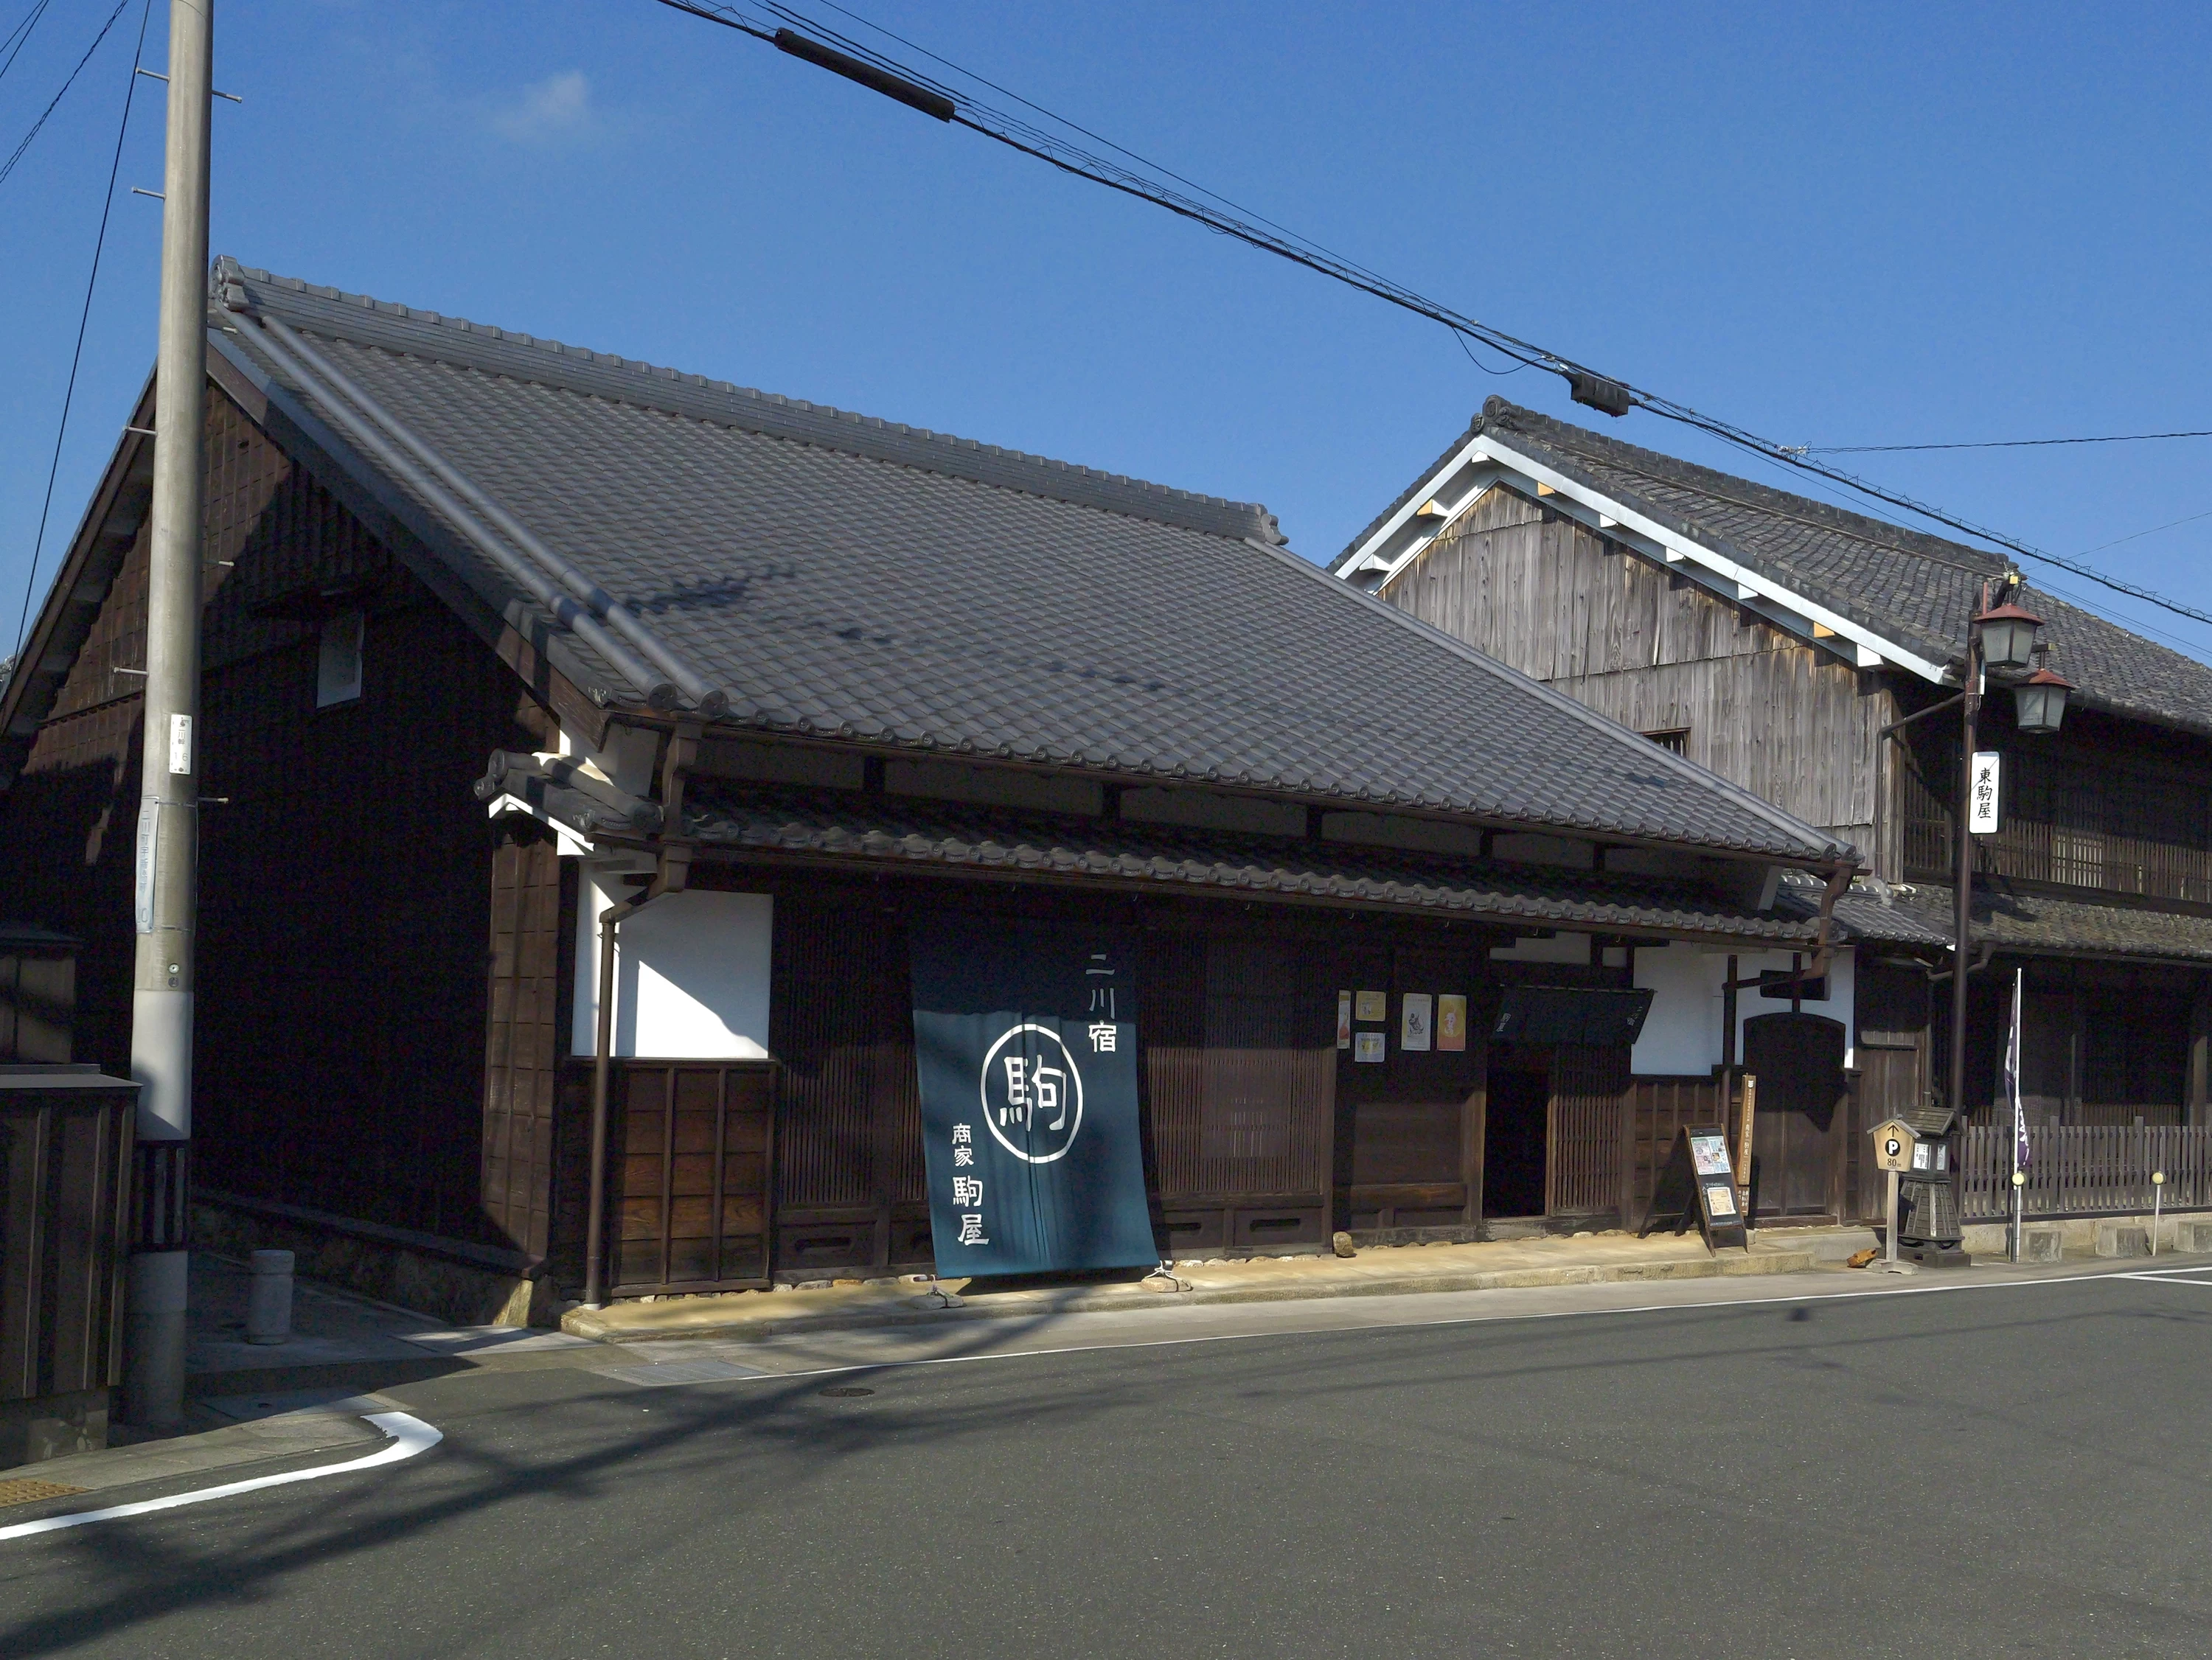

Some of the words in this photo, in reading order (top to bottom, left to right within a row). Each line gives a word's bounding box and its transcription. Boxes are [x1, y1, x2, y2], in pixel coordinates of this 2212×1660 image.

[1976, 767, 1993, 819] 東駒屋
[1085, 954, 1117, 1053] 二川宿
[1000, 1055, 1068, 1131] 駒
[1888, 1140, 1899, 1154] P
